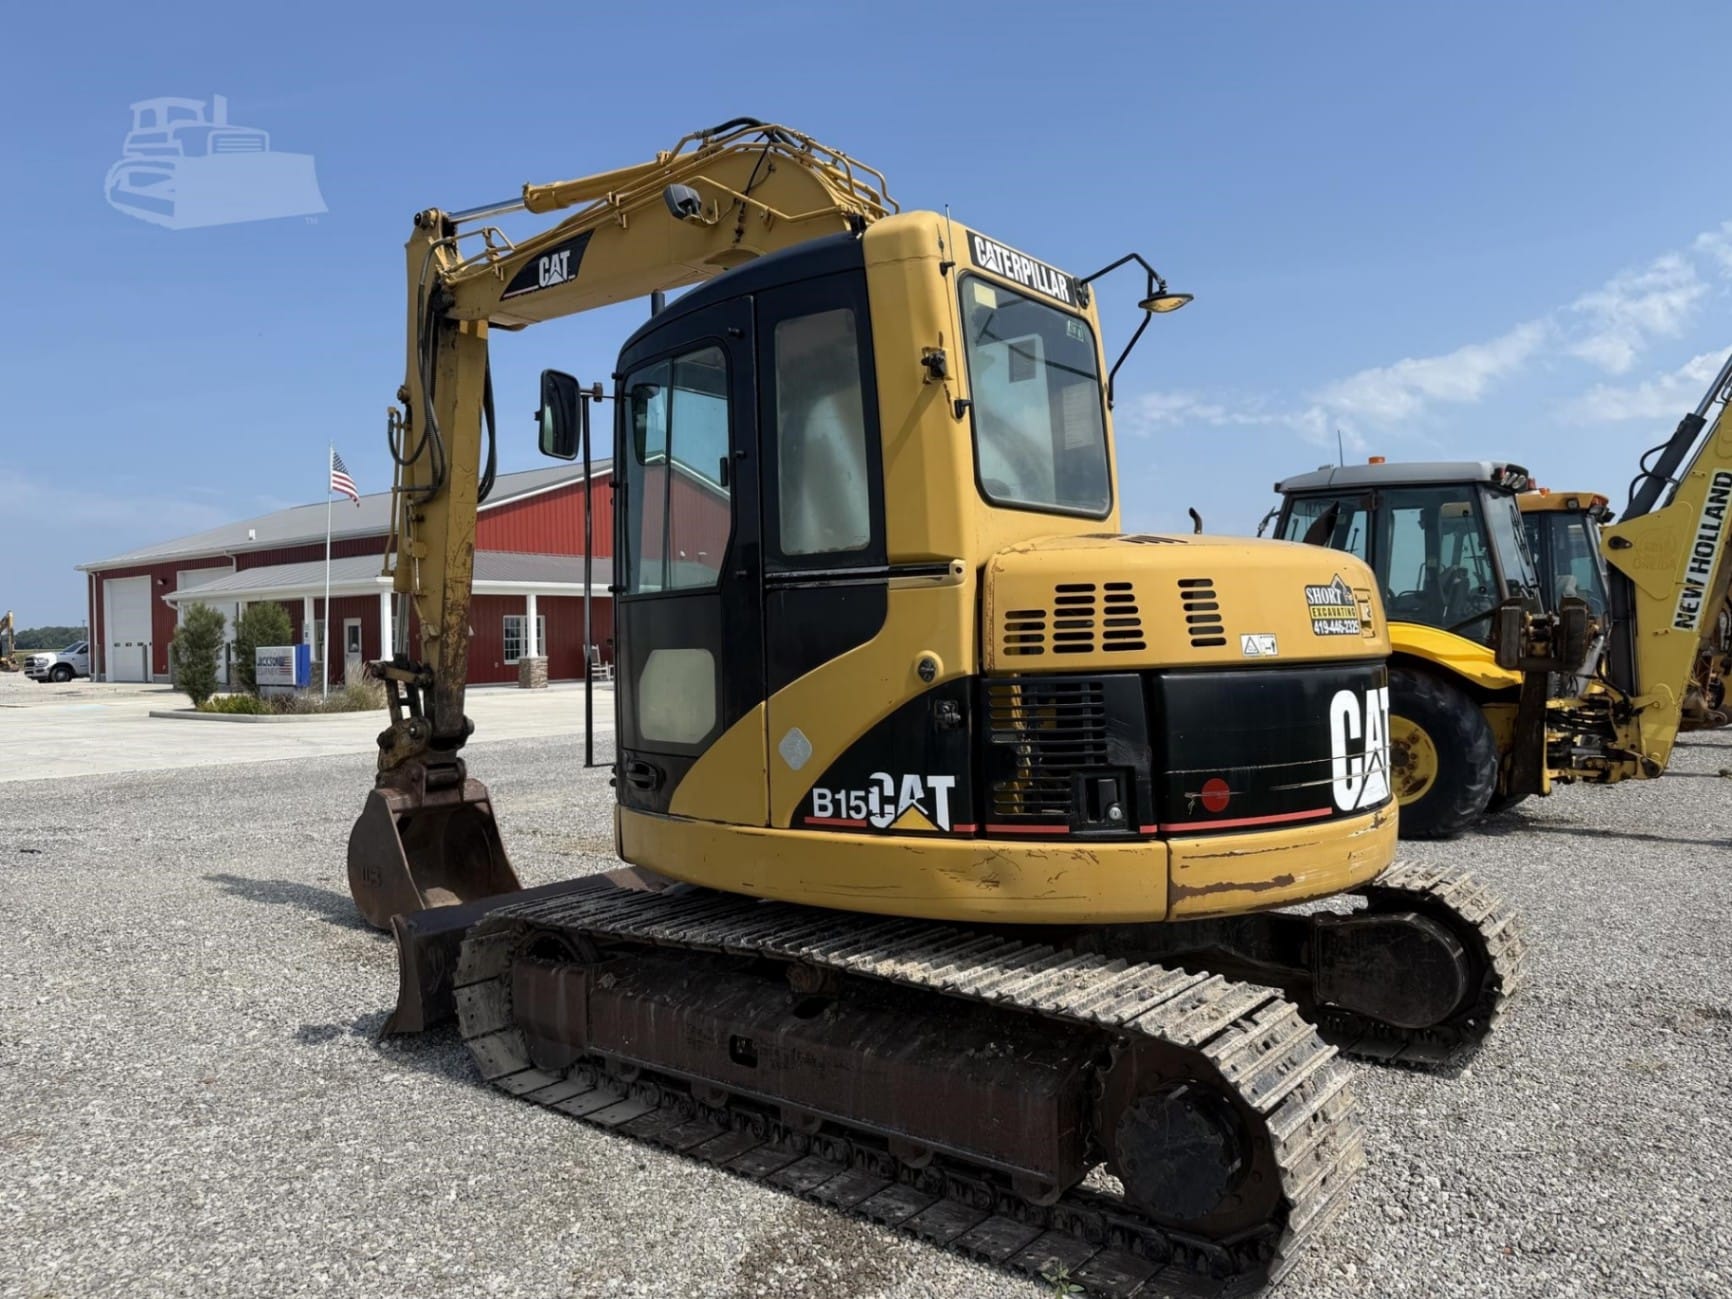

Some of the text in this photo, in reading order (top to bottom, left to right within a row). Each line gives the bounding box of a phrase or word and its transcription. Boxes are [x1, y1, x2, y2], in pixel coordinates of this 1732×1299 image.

[539, 249, 571, 288] CAT
[974, 236, 1071, 303] CATERPILLAR
[1674, 471, 1732, 631] NEW HOLLAND
[1306, 586, 1342, 605] SHORT
[1311, 607, 1356, 618] EXCAVATING
[868, 771, 956, 832] CAT
